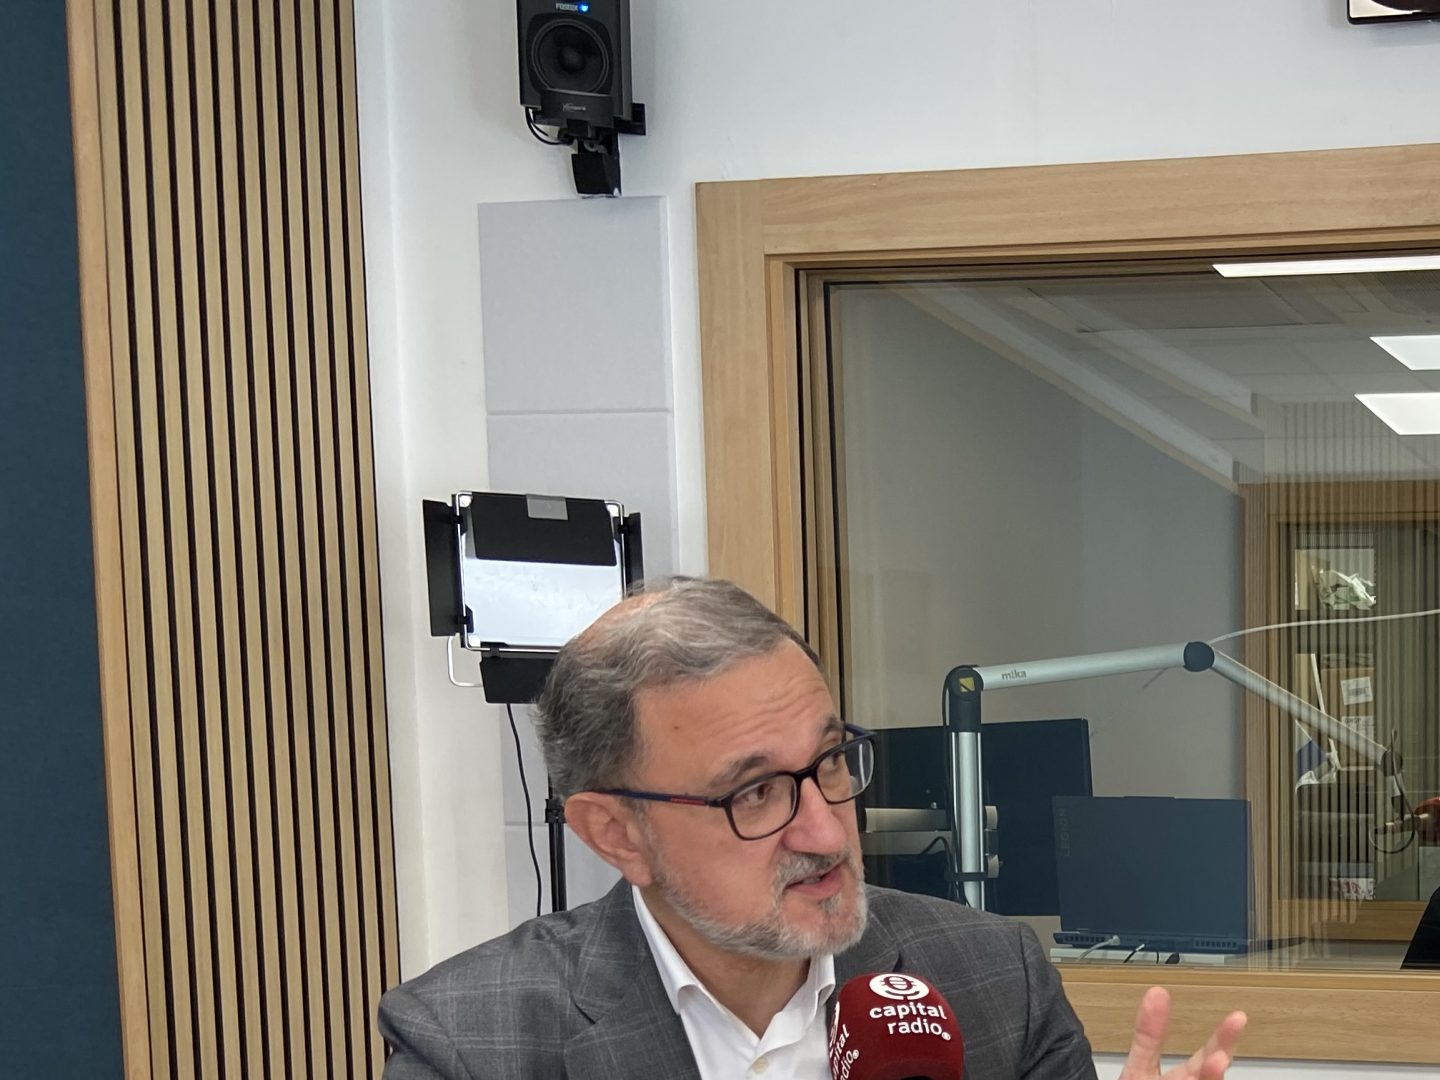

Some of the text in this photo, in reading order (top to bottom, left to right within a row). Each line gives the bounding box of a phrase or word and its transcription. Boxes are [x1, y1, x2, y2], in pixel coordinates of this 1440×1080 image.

[1001, 669, 1027, 680] mika
[869, 1001, 947, 1020] capital
[887, 1017, 943, 1035] radio
